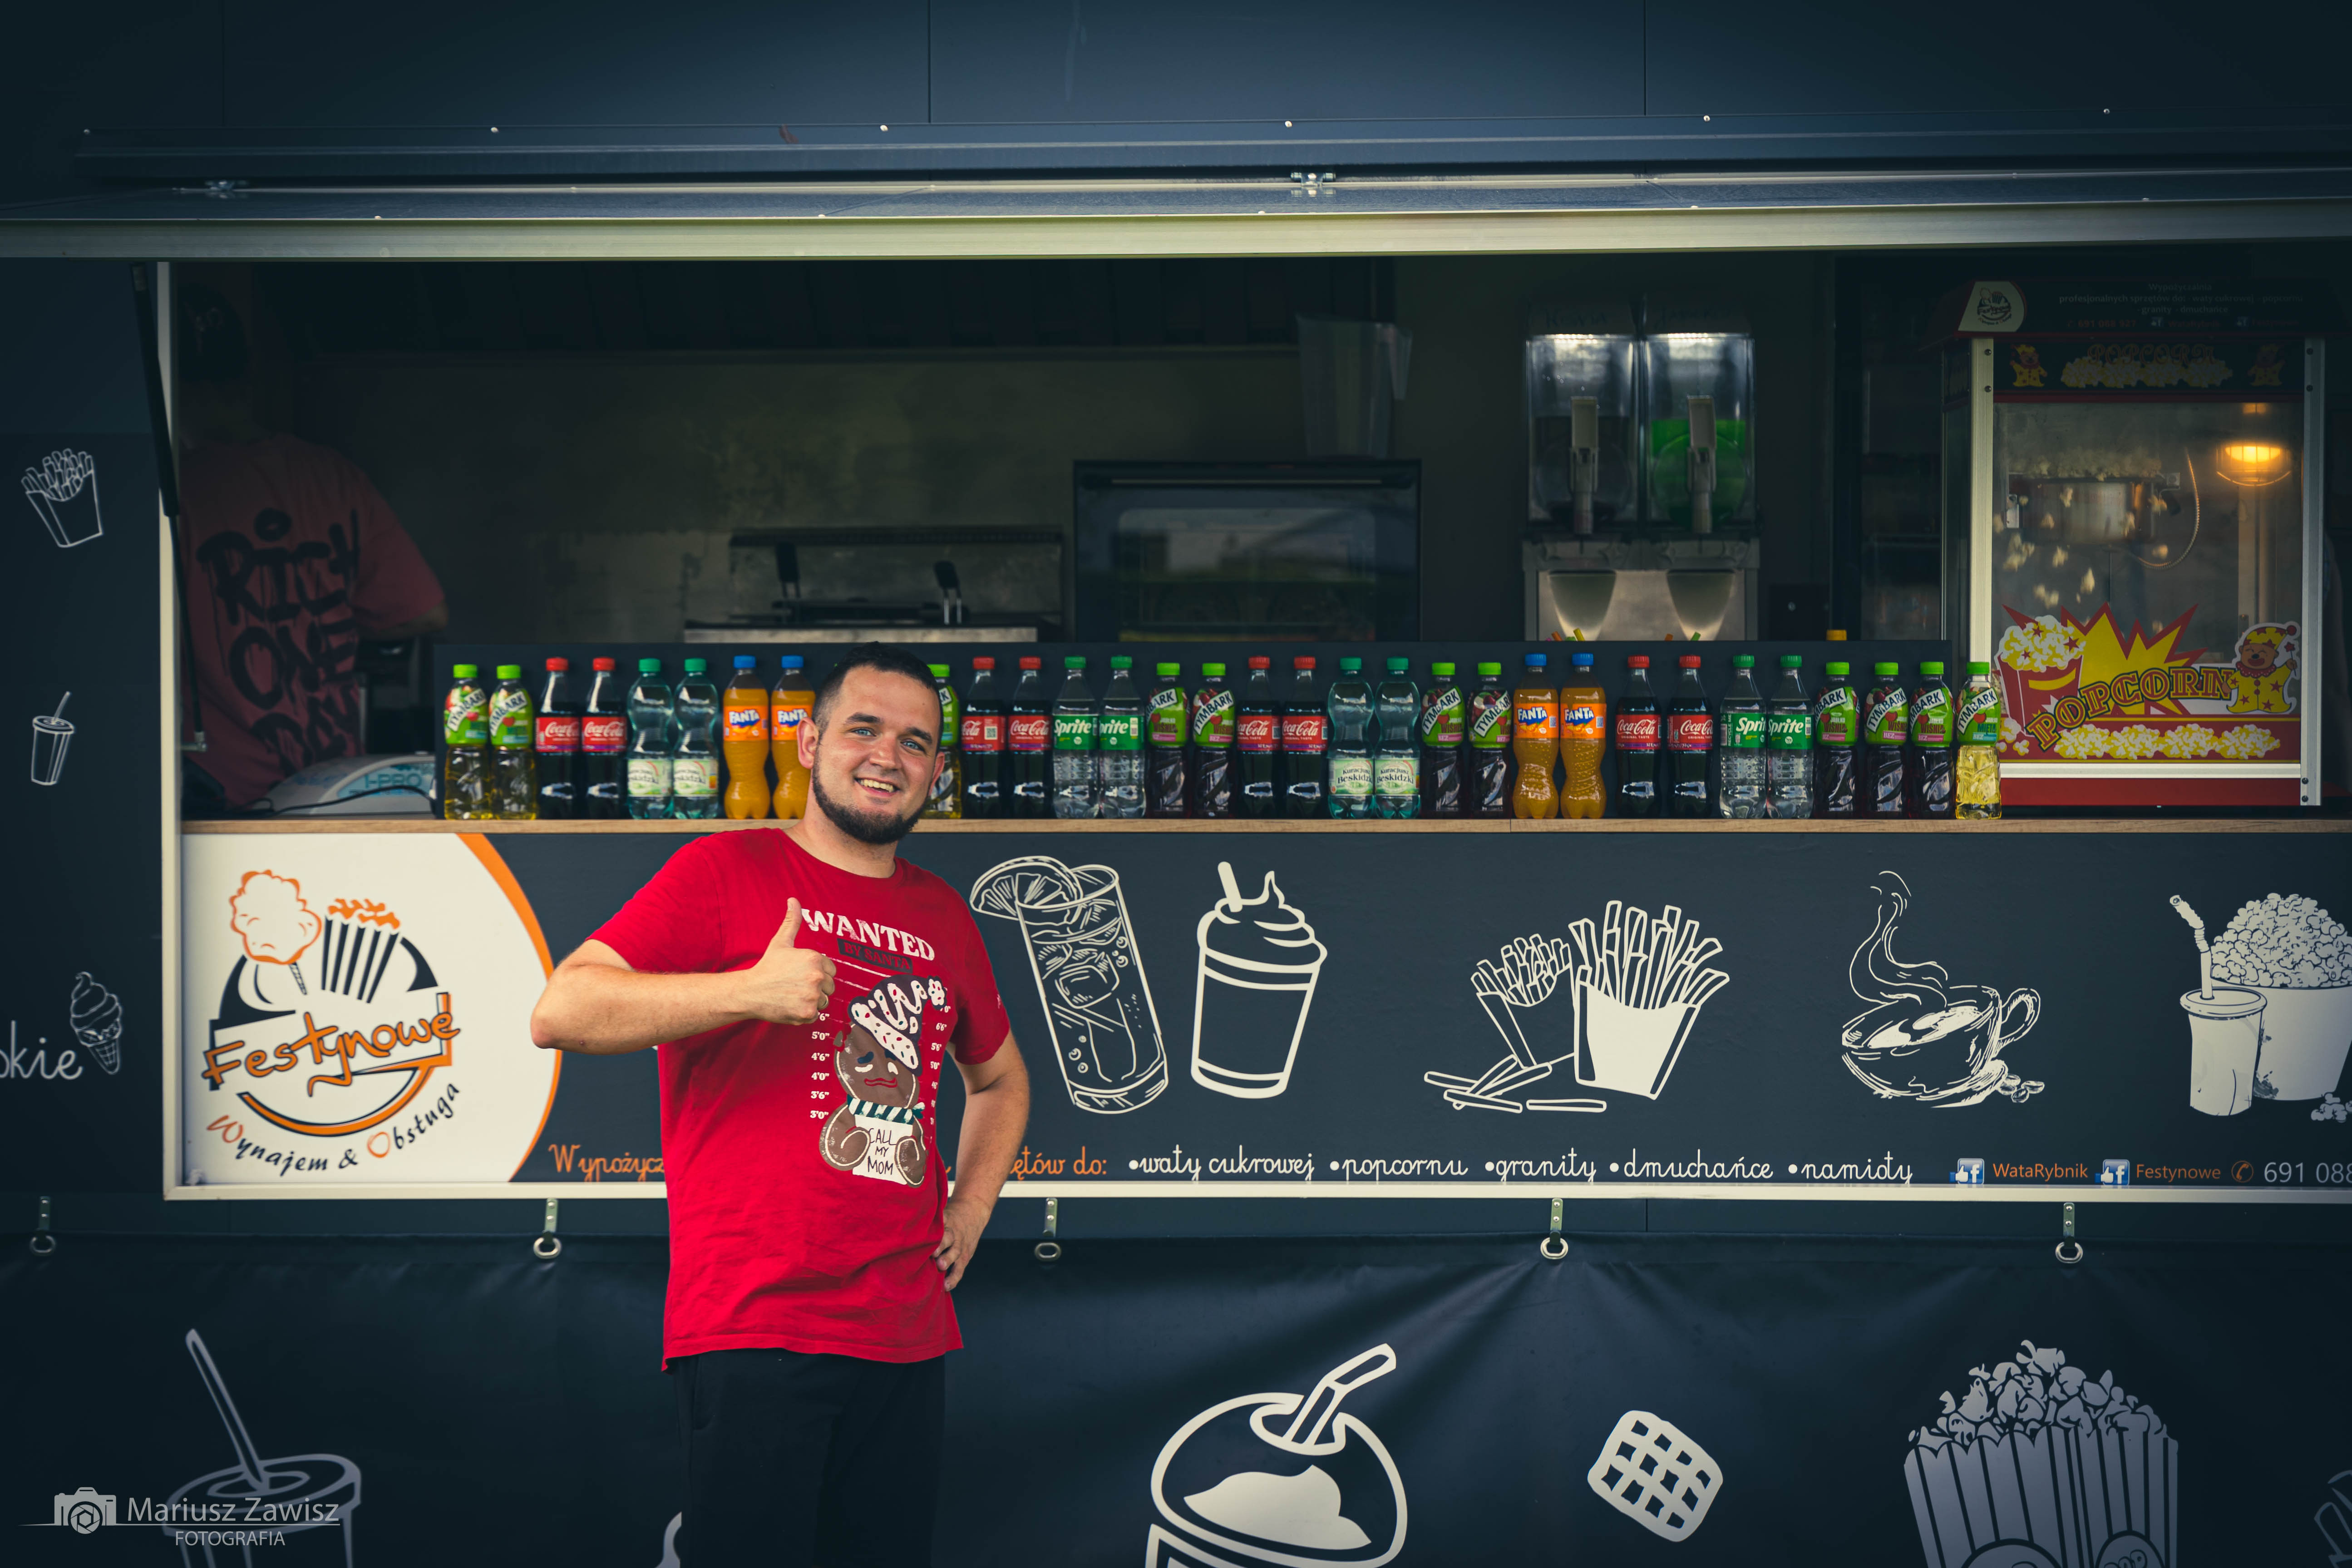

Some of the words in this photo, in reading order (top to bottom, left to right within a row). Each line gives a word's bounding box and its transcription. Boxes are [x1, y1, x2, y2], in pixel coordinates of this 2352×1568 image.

[2059, 294, 2128, 304] profesjonalnych
[2087, 343, 2215, 364] POPCORN
[777, 708, 808, 723] FANTA
[1146, 691, 1174, 720] MBARK
[1195, 693, 1233, 730] TYMBARK
[1423, 690, 1460, 730] TYMBARK
[1517, 707, 1548, 721] FANTA
[1564, 707, 1594, 721] FANTA
[1815, 690, 1844, 720] MBARK
[1868, 690, 1906, 727] TYMBARK
[1910, 691, 1942, 726] MBARK
[1958, 690, 1996, 729] TYMBARK
[2026, 666, 2235, 752] POPCORN
[729, 709, 759, 724] FANTA
[1099, 719, 1129, 735] rite
[1768, 718, 1804, 736] Sprite
[1054, 719, 1092, 737] Sprite
[1238, 720, 1270, 736] oca-Cola
[801, 908, 935, 961] WANTED
[844, 942, 862, 957] BY
[864, 948, 911, 970] SANTA
[818, 1011, 830, 1021] '6"
[201, 1012, 461, 1097] Festynowe
[206, 1114, 328, 1177] Wynajem
[339, 1149, 359, 1169] &
[868, 1128, 897, 1146] CALL
[875, 1146, 889, 1157] MY
[868, 1155, 894, 1175] MOM
[1073, 1145, 1107, 1175] do:
[1140, 1144, 1202, 1181] waty
[1209, 1144, 1315, 1181] cukrowej
[1342, 1158, 1469, 1181] popcornu
[1495, 1147, 1597, 1182] granity
[1624, 1148, 1774, 1180] dmuchańce
[1801, 1151, 1913, 1183] namioty
[1992, 1163, 2088, 1182] WataRybnik
[2137, 1164, 2221, 1181] Festynowe
[2264, 1162, 2303, 1183] 691
